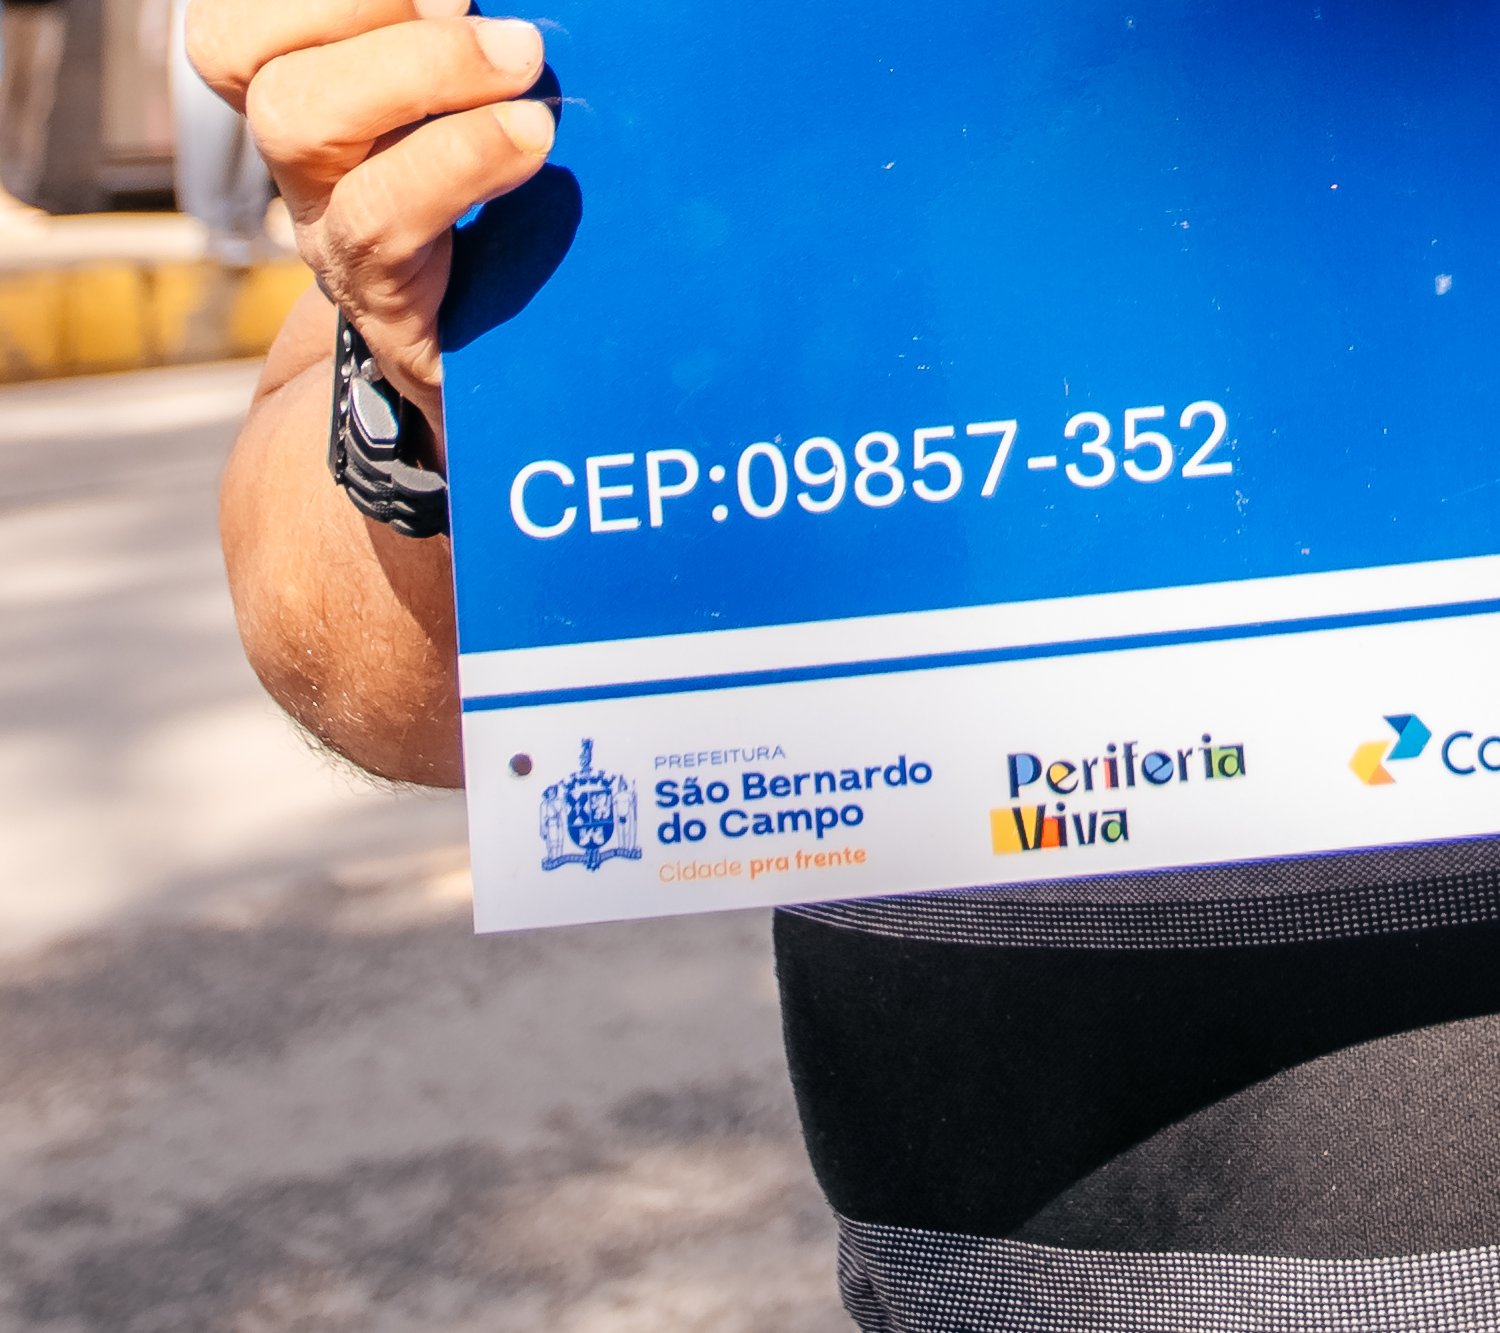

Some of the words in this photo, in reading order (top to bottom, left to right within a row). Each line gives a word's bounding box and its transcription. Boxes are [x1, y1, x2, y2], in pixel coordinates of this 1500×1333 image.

[509, 400, 1234, 539] CEP:09857-352
[654, 745, 787, 770] PREFEITURA
[655, 775, 731, 808] São
[742, 755, 933, 801] Bernardo
[1007, 733, 1246, 799] Periferia
[657, 812, 707, 844] do
[719, 802, 864, 839] Campo
[1011, 801, 1130, 852] Viva
[658, 857, 743, 884] Cidade
[749, 857, 790, 880] pra
[794, 846, 867, 870] frente
